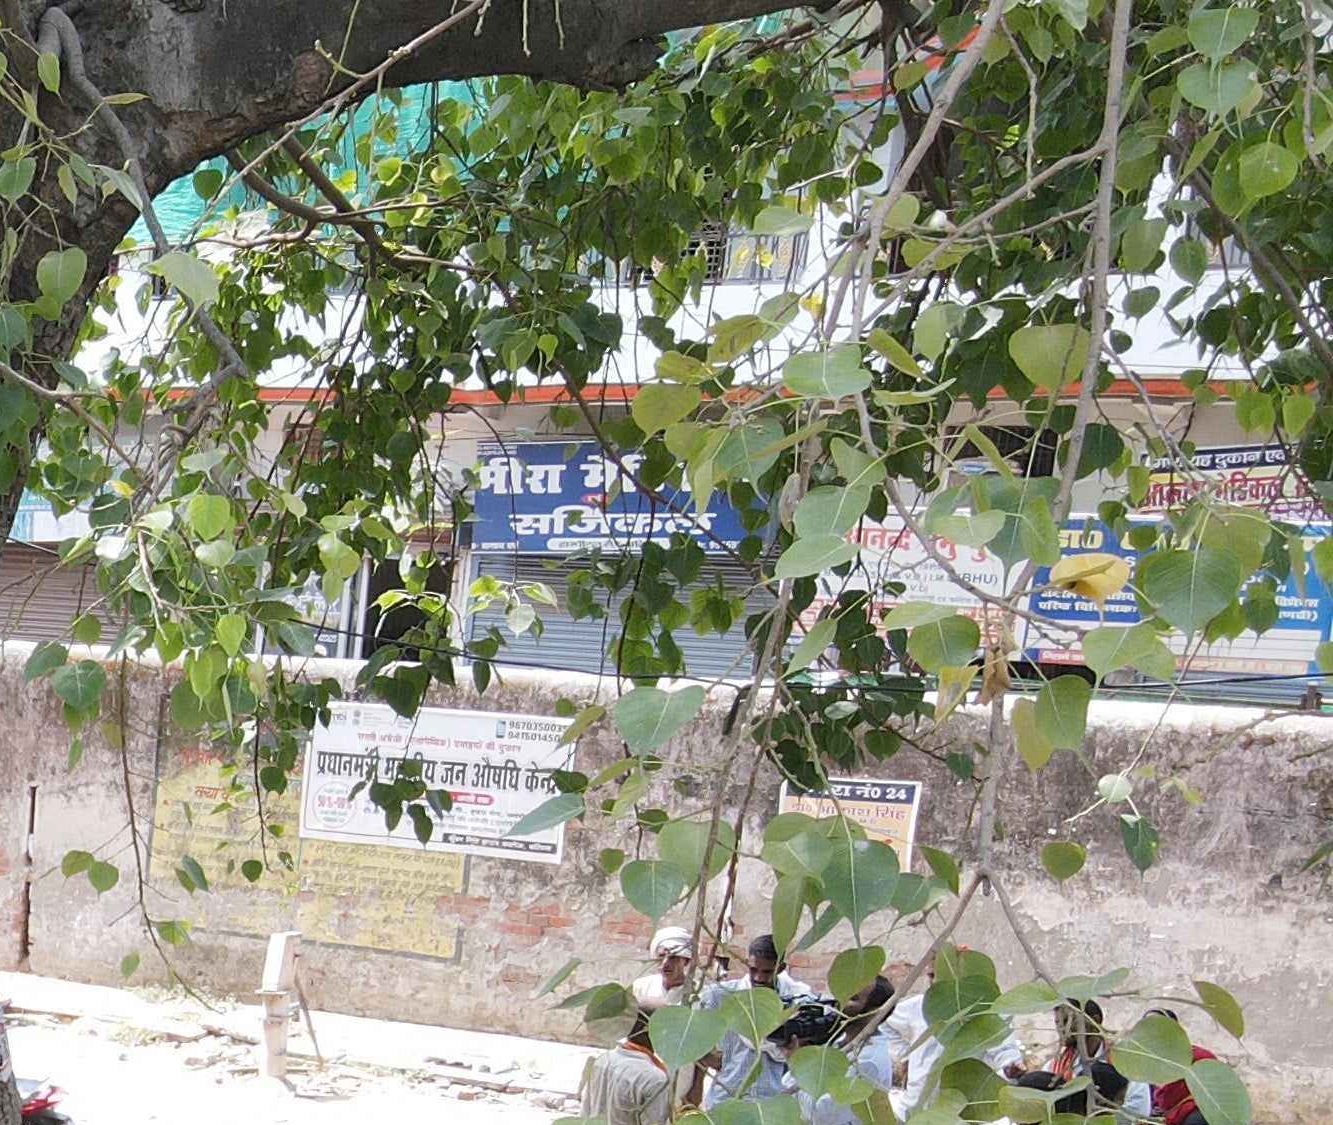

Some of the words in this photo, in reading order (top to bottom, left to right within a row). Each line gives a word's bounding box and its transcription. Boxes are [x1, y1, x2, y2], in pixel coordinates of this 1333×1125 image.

[479, 457, 567, 494] मीरा
[441, 761, 468, 785] जन
[885, 787, 907, 800] 24
